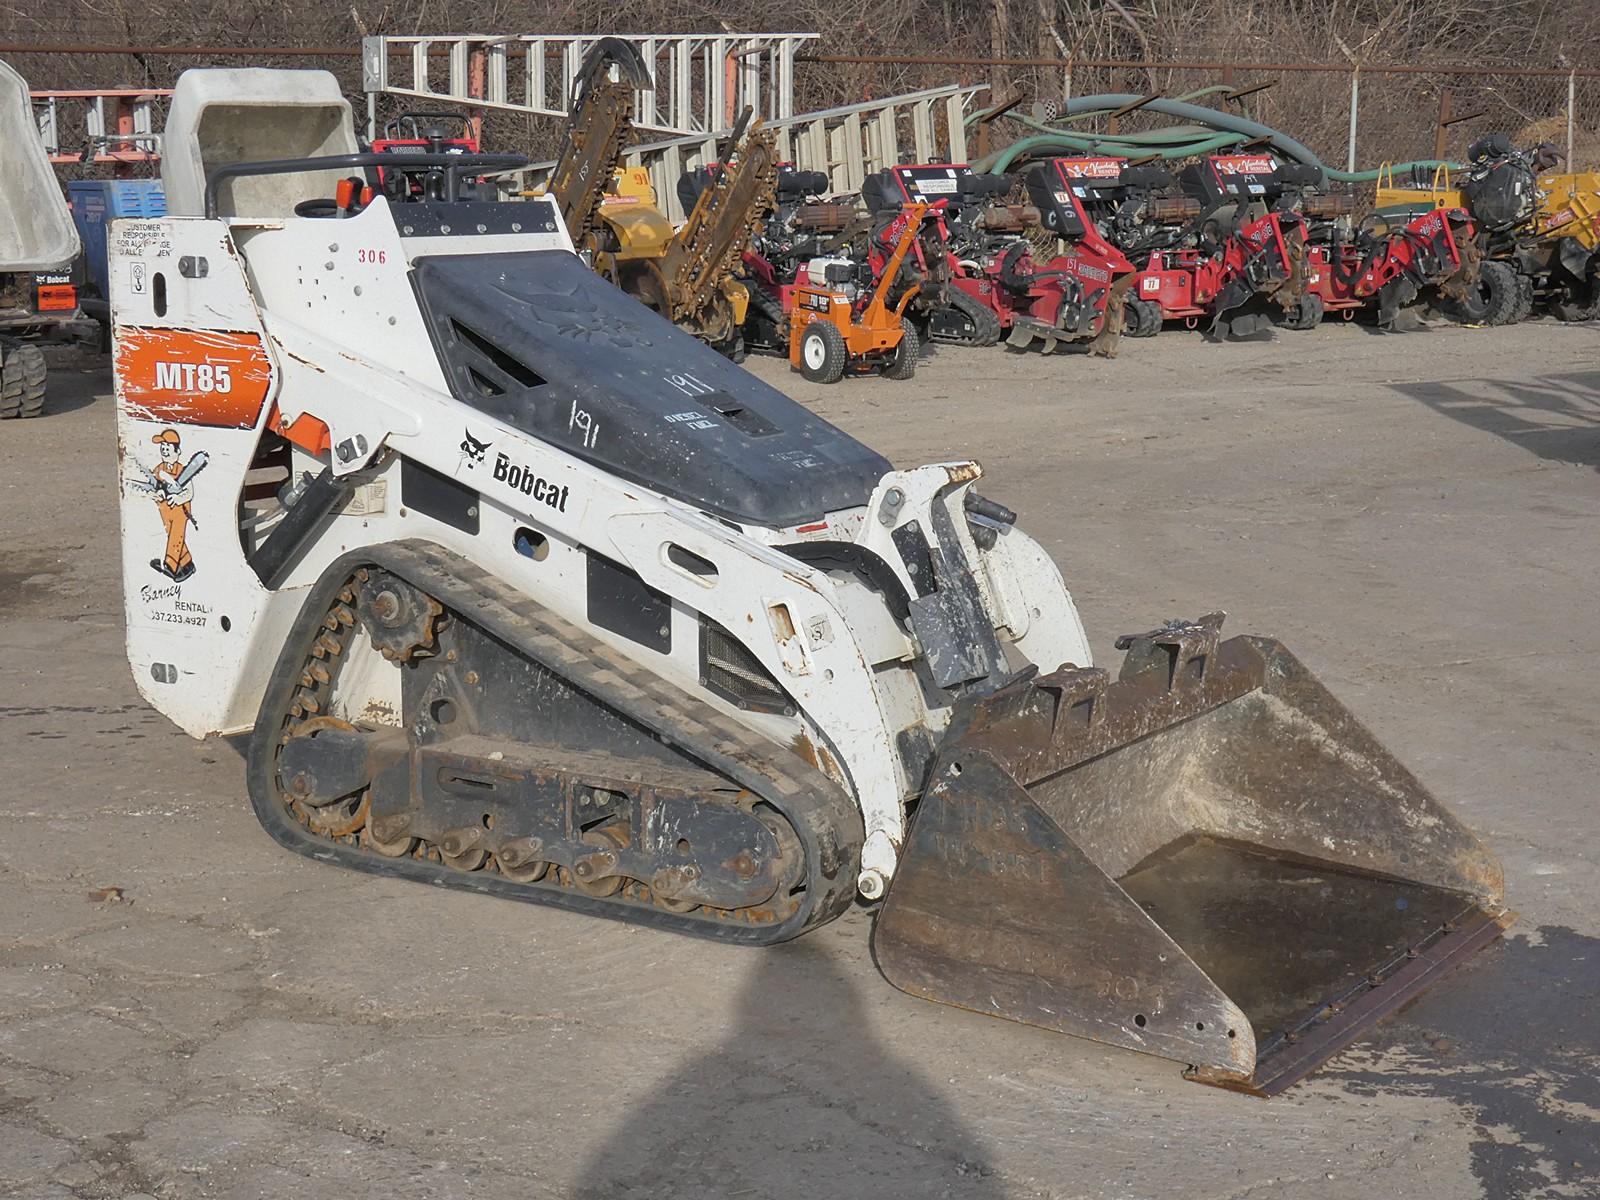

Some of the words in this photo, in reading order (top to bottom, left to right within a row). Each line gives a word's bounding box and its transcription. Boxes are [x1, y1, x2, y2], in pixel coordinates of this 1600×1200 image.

[126, 223, 162, 232] USTOMER
[358, 249, 386, 265] 306
[154, 361, 232, 394] MT85
[663, 372, 715, 397] 191
[568, 399, 600, 449] 191
[493, 451, 569, 514] Bobcat
